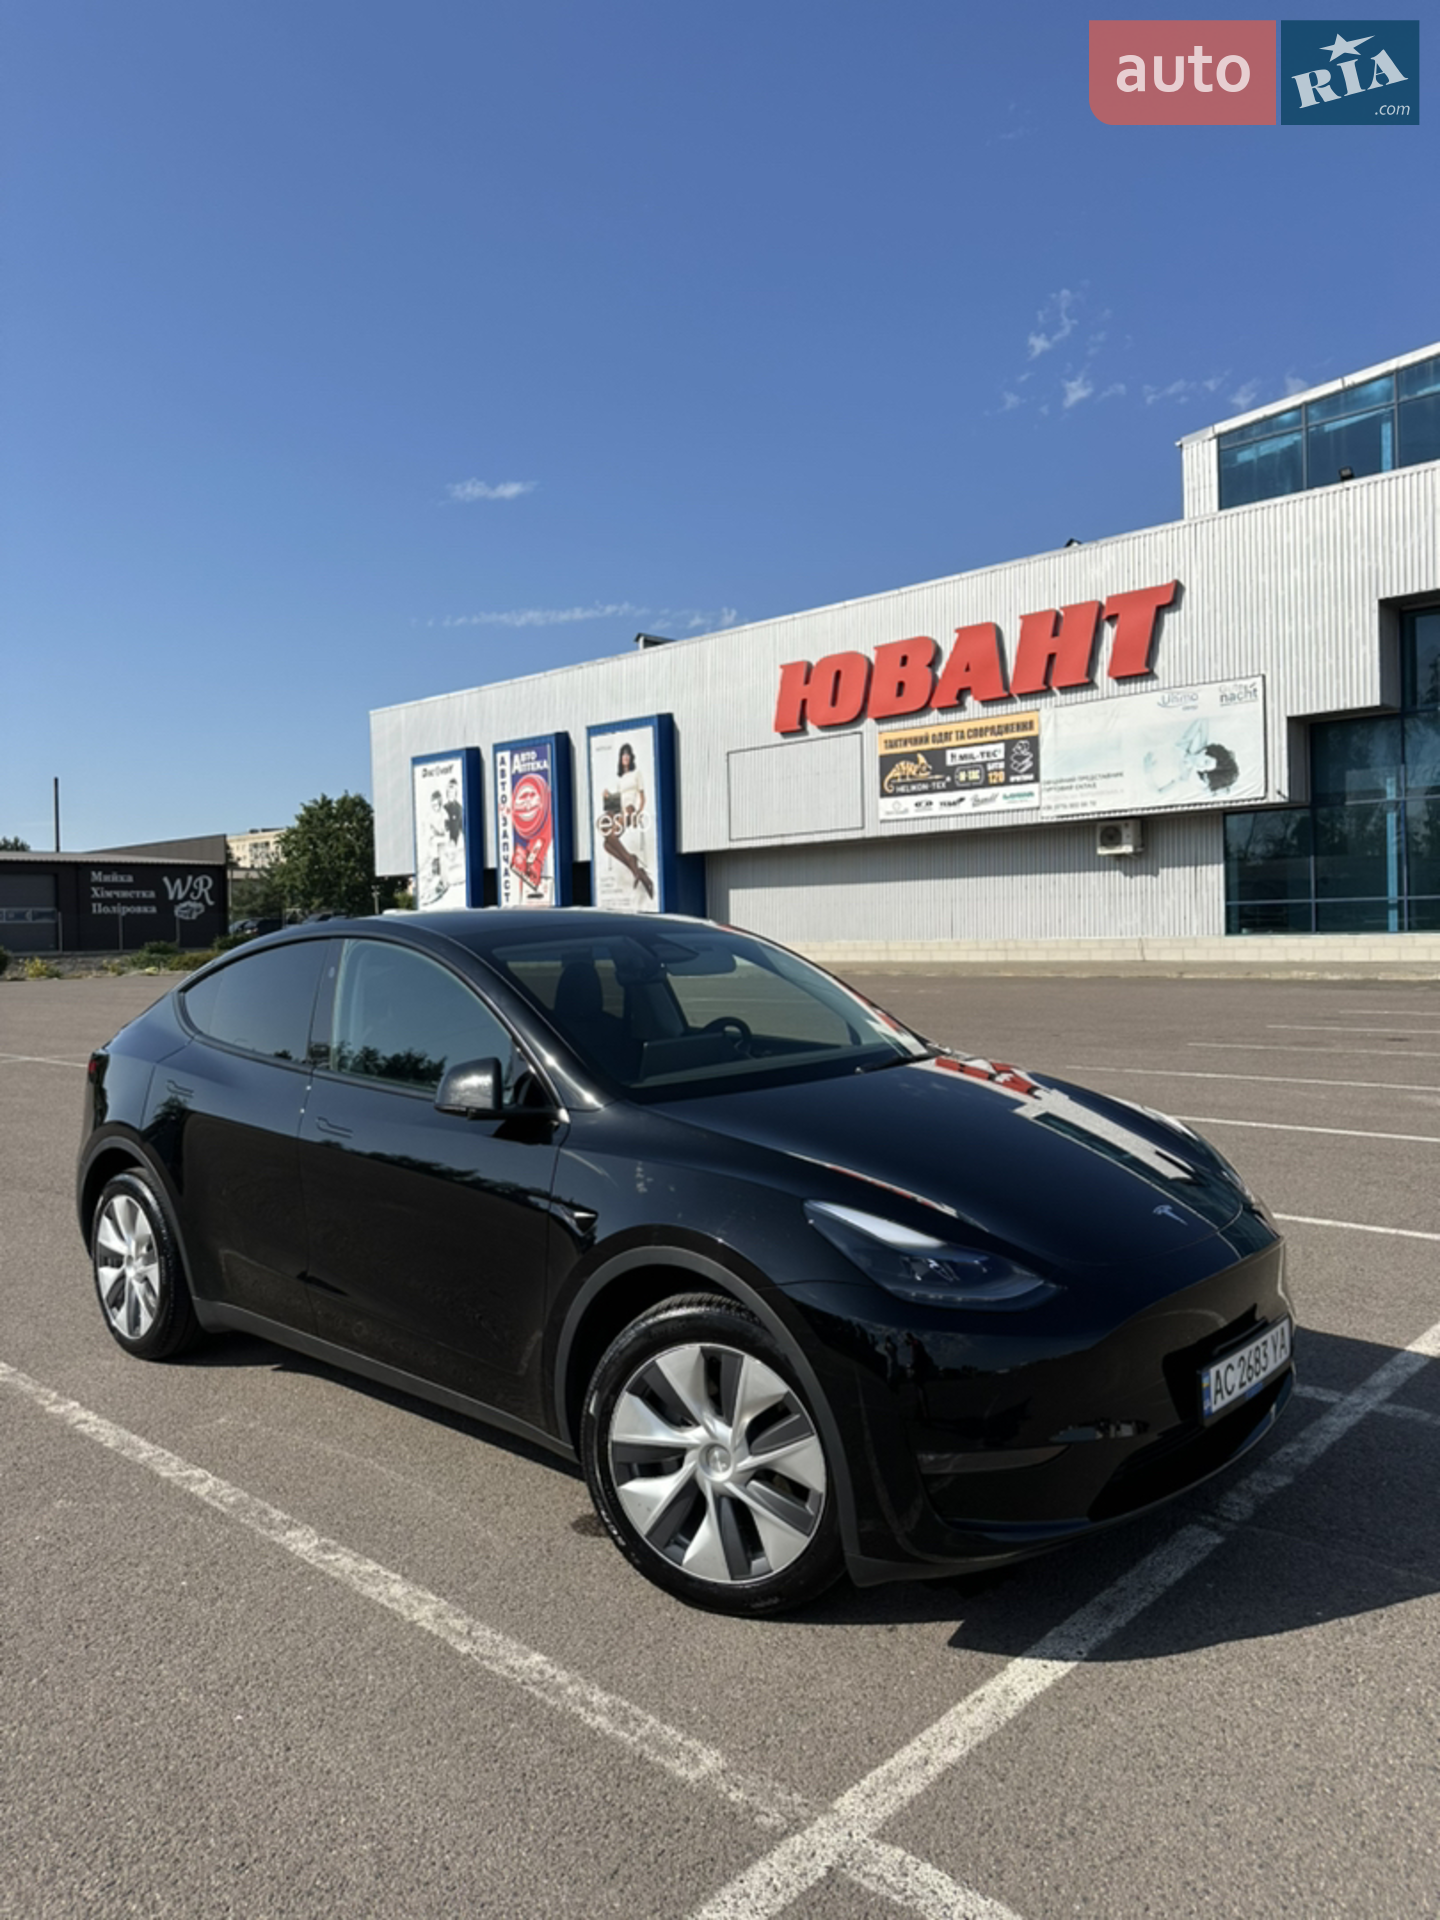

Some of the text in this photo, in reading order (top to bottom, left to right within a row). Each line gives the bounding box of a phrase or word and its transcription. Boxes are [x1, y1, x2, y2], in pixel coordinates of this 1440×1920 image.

[773, 579, 1180, 734] ЮВАНТ
[955, 727, 965, 741] ТА
[90, 871, 134, 883] Мийка
[91, 887, 156, 899] Хімчистка
[91, 902, 157, 916] Поліровка
[1213, 1363, 1236, 1406] AC
[1237, 1340, 1269, 1389] 2683
